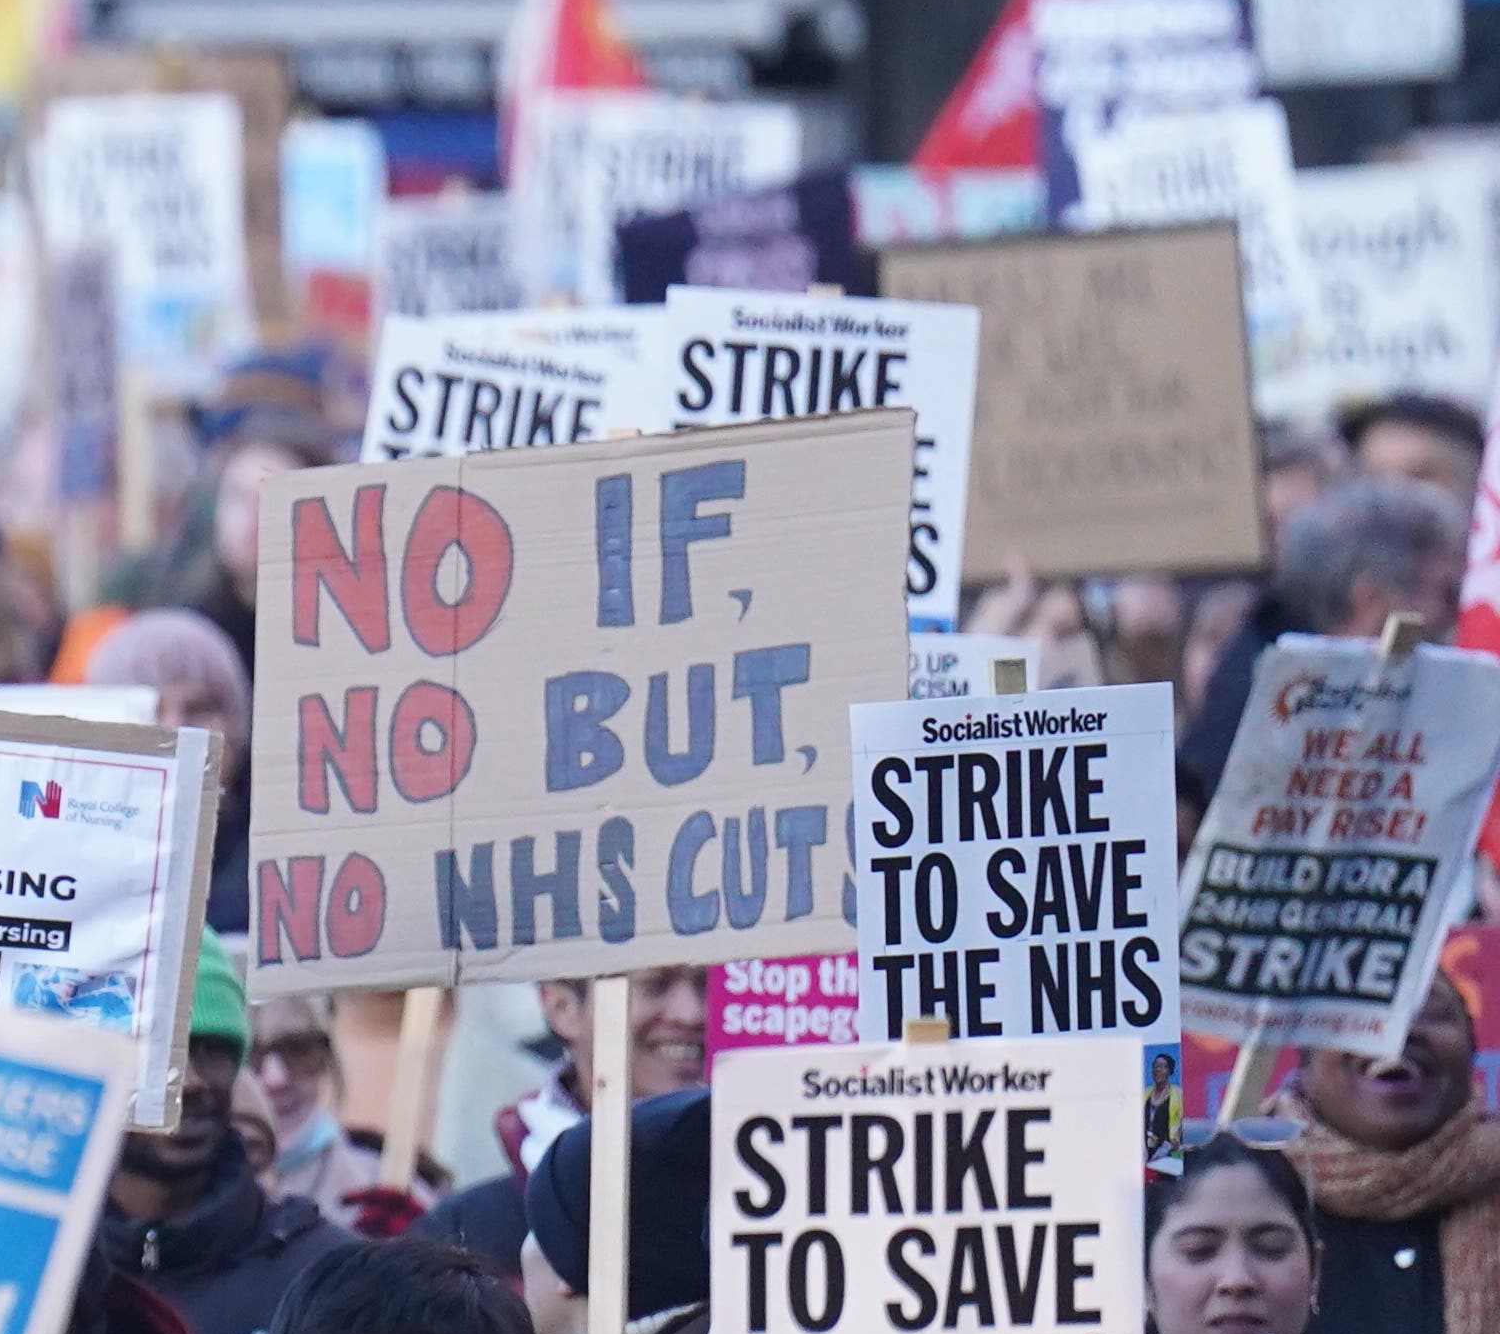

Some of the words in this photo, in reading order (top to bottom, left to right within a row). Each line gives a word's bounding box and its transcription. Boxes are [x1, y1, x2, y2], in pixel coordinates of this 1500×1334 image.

[292, 483, 514, 657] NO
[594, 459, 756, 629] IF,
[926, 651, 960, 674] UP
[298, 678, 477, 815] NO
[545, 643, 818, 793] BUT,
[922, 713, 1024, 745] Socialist
[1026, 708, 1108, 738] Worker
[1305, 729, 1361, 760] WE
[1364, 731, 1426, 765] ALL
[870, 743, 1110, 849] STRIKE
[1285, 769, 1382, 800] NEED
[1388, 771, 1413, 800] A
[1250, 806, 1320, 837] PAY
[1329, 809, 1427, 844] RISE!
[257, 851, 386, 968] NO
[434, 816, 637, 952] NHS
[869, 857, 959, 947] TO
[987, 840, 1148, 939] SAVE
[1206, 847, 1322, 893] BUILD
[1324, 858, 1392, 895] FOR
[1396, 863, 1427, 898] A
[1279, 899, 1416, 935] GENERAL
[722, 957, 811, 1003] Stop
[1031, 936, 1163, 1035] NHS
[802, 1069, 935, 1101] Socialist
[939, 1063, 1052, 1095] Worker
[734, 1109, 1052, 1219] STRIKE
[731, 1229, 846, 1334] TO
[885, 1222, 1101, 1332] SAVE
